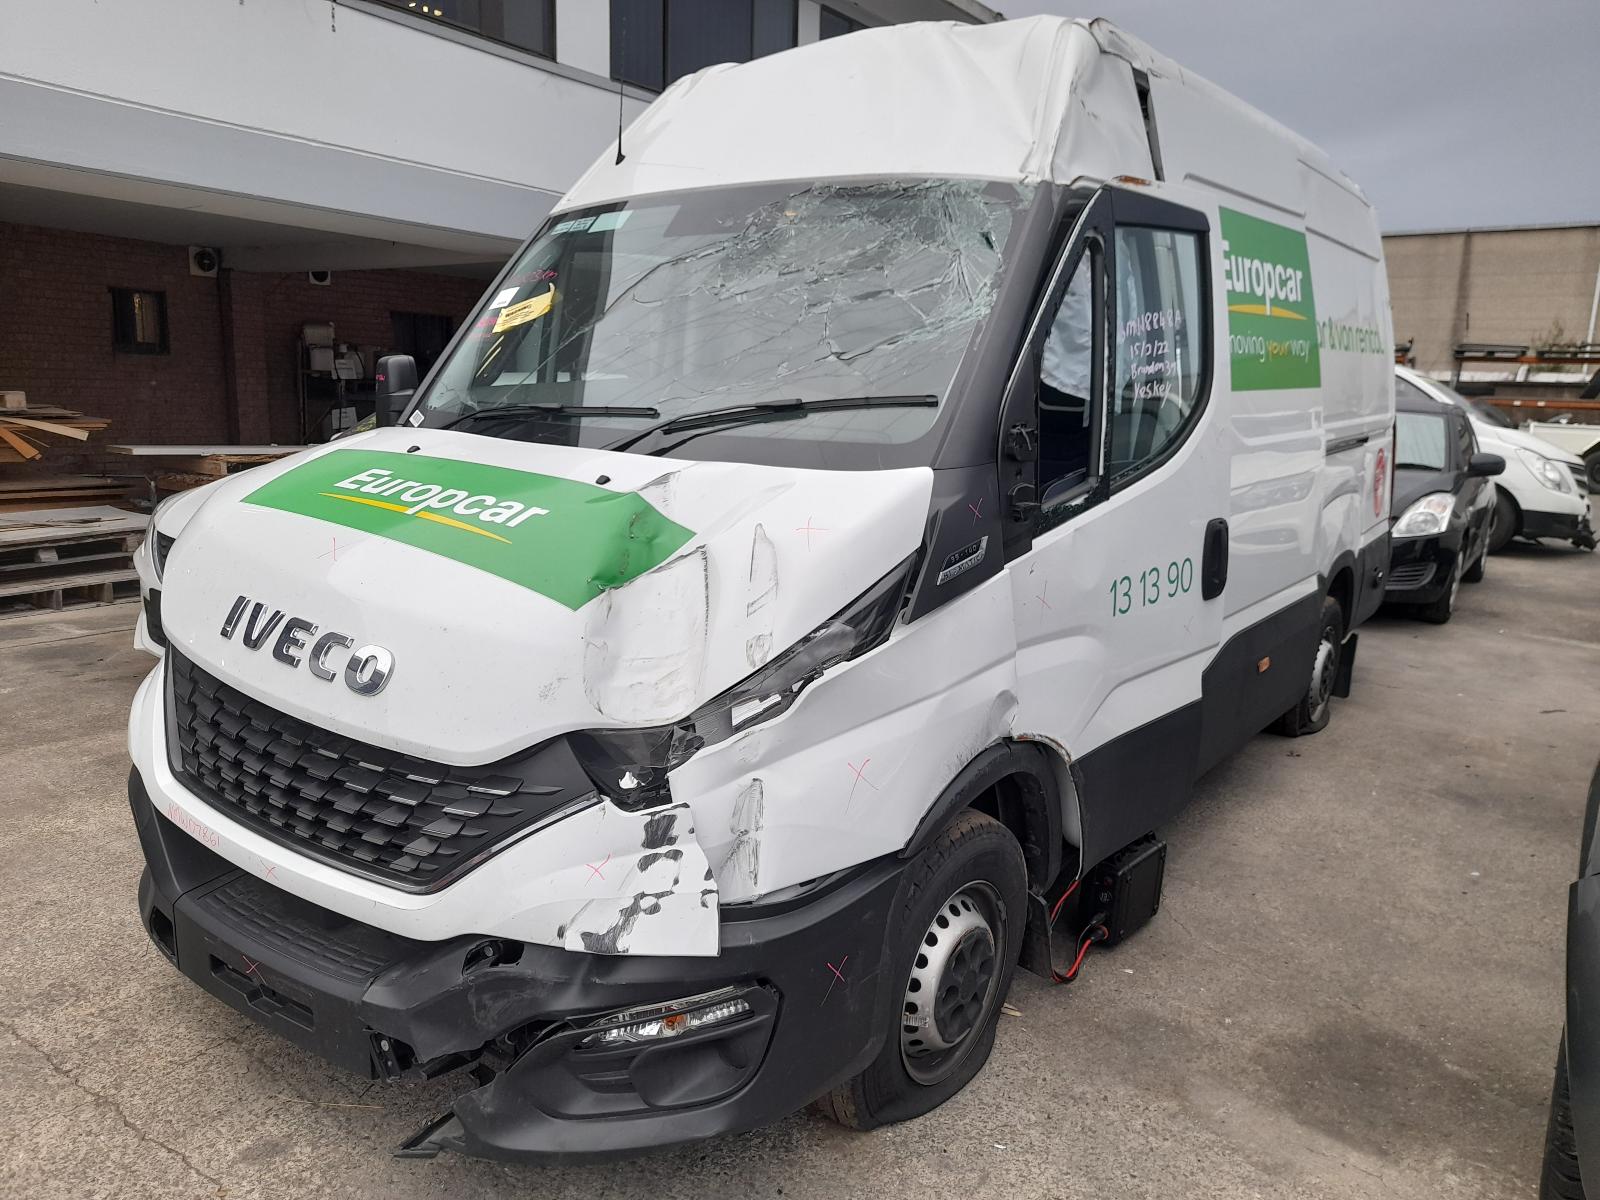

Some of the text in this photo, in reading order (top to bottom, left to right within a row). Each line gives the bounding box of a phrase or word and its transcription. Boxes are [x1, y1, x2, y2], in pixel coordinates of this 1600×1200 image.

[1220, 239, 1303, 316] Europcar
[1266, 338, 1289, 362] your
[1290, 338, 1310, 363] way
[334, 468, 549, 529] Europcar
[1110, 557, 1193, 617] 13 13 90
[219, 594, 396, 697] IVECO
